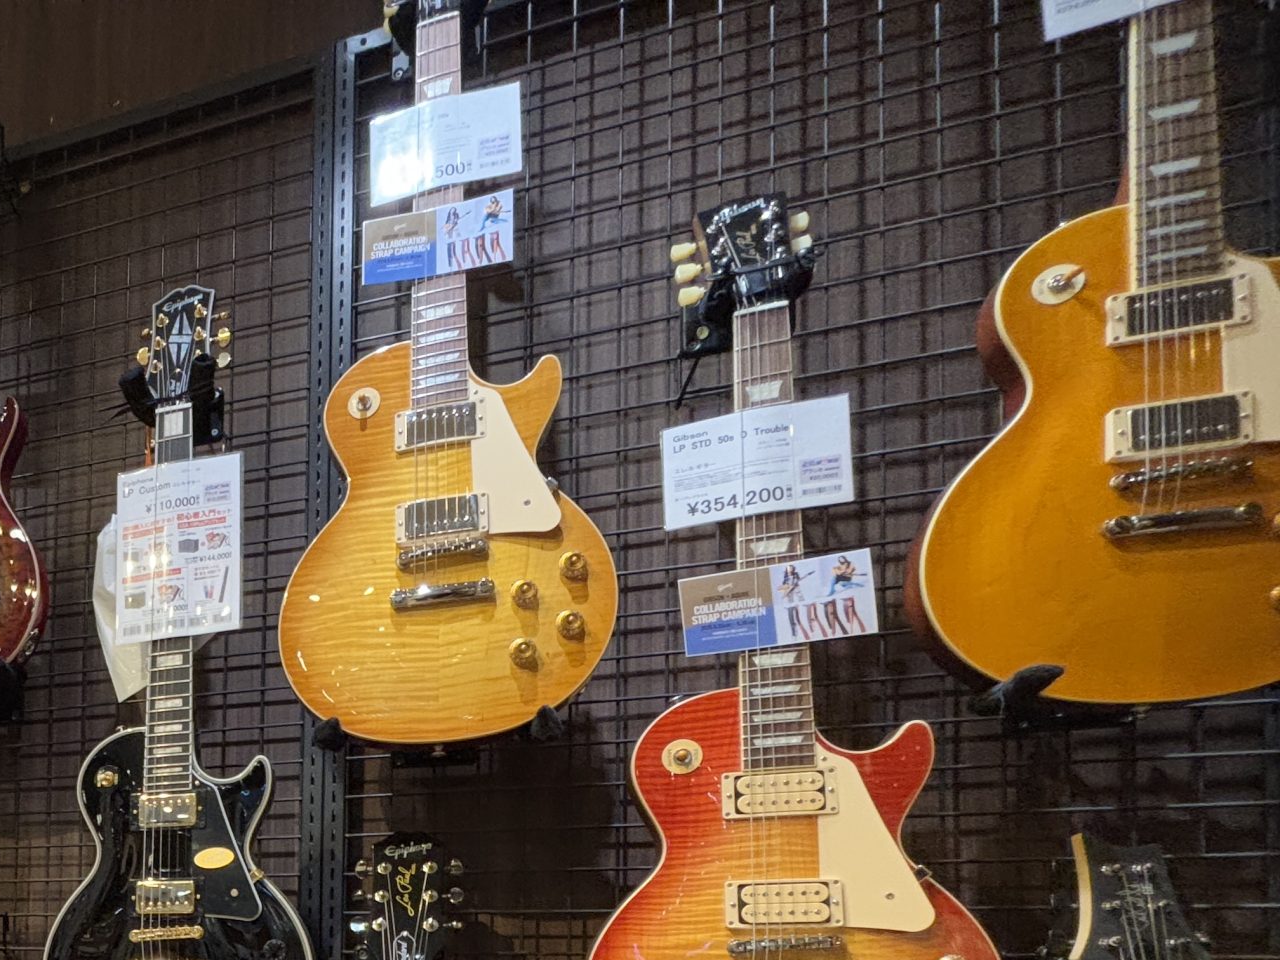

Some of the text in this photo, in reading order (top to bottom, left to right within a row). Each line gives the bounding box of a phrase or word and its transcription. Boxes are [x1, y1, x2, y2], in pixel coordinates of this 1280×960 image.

[673, 430, 709, 444] Gibson
[673, 443, 687, 455] LP
[691, 438, 712, 450] STD
[754, 424, 790, 437] Trouble
[138, 482, 171, 495] Custom
[687, 485, 786, 517] ¥354,200
[691, 612, 720, 626] STRAP
[384, 841, 433, 860] Epiphone
